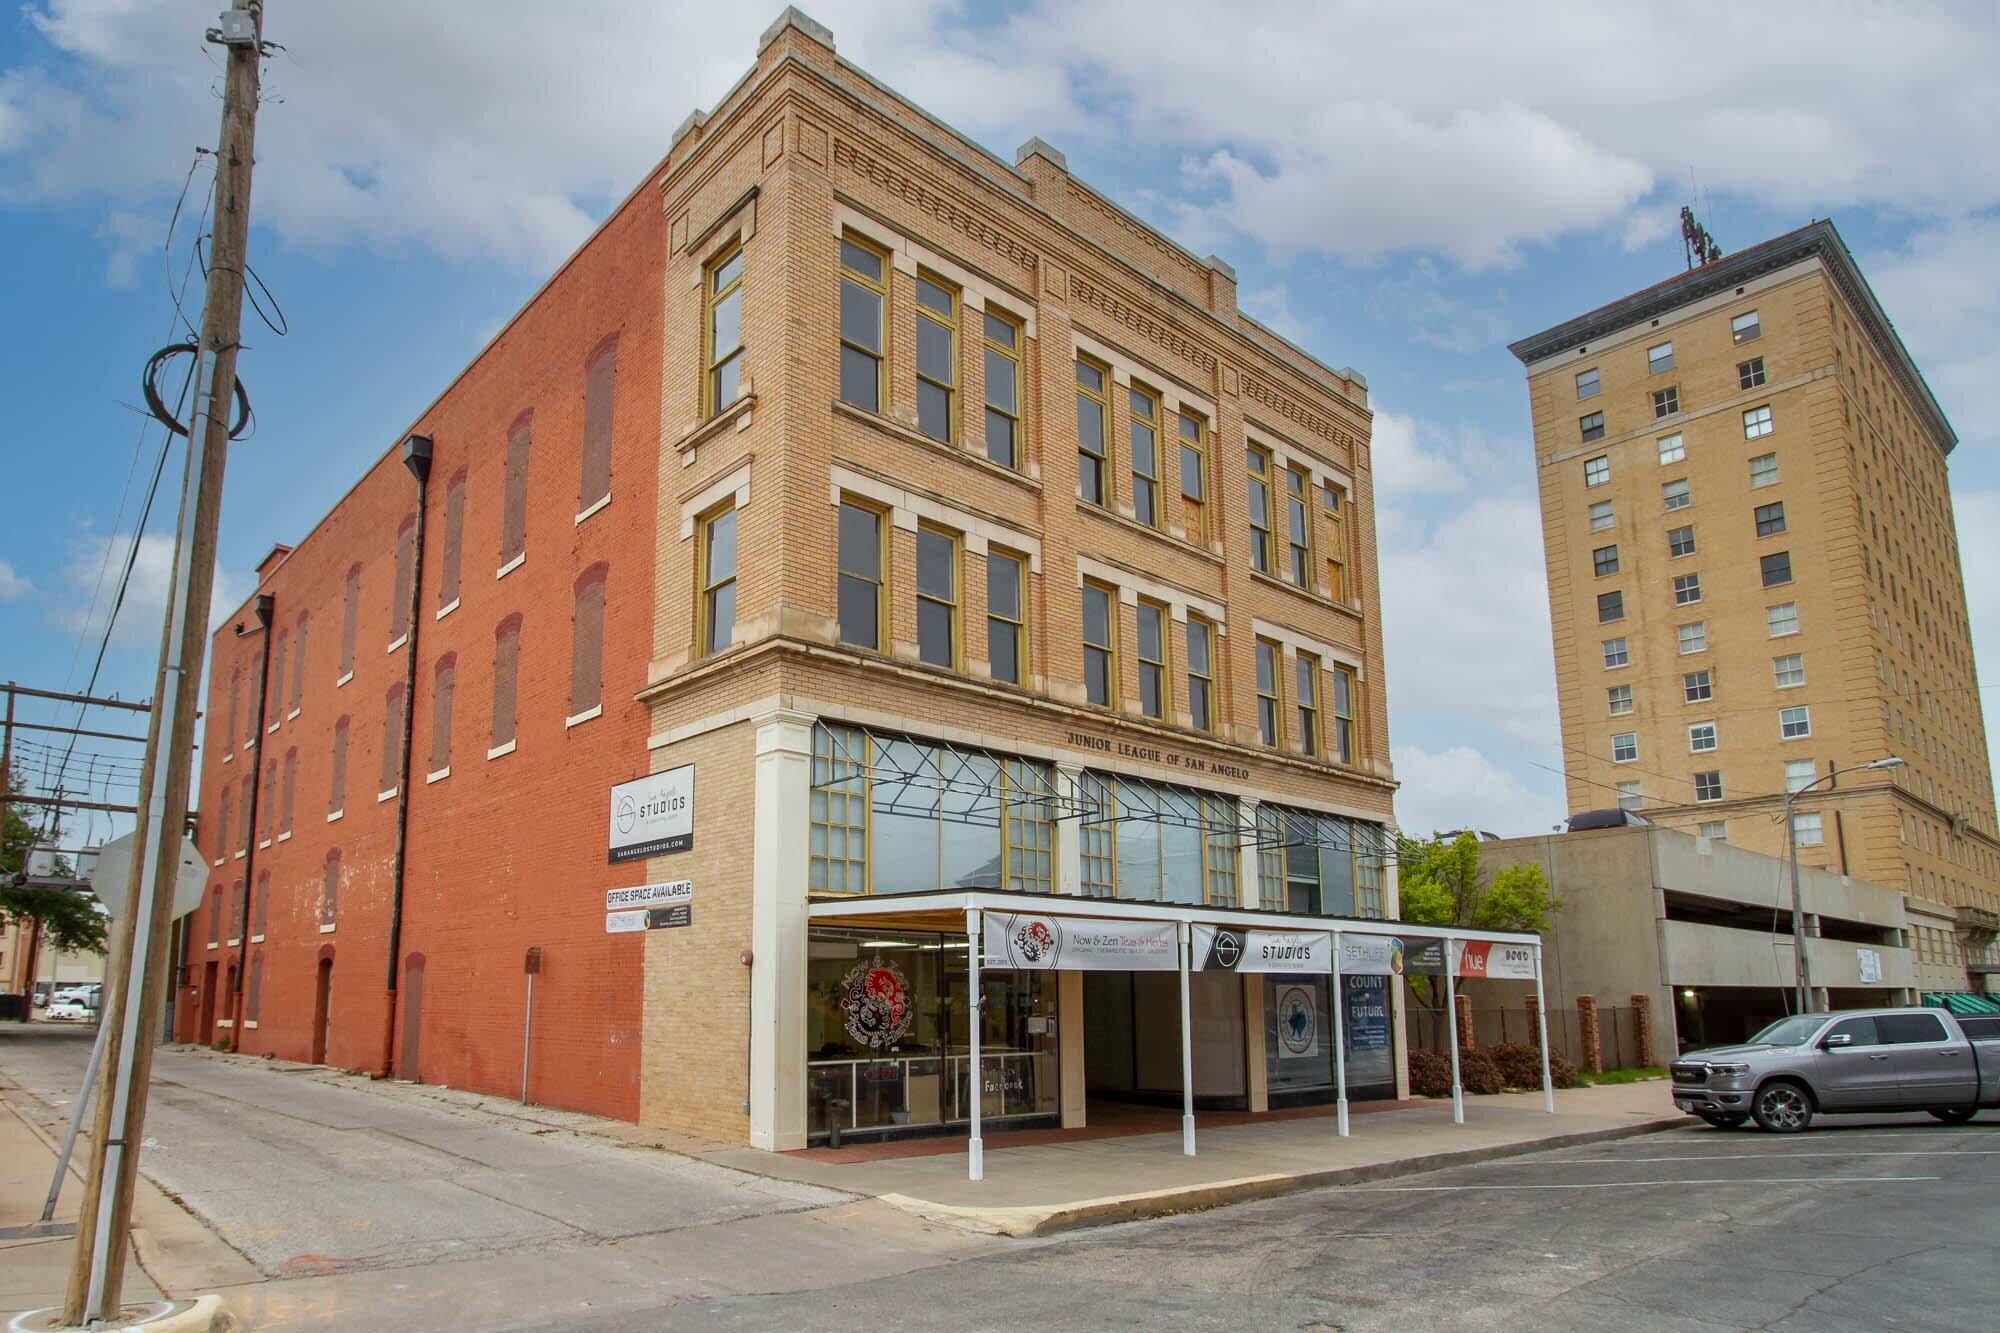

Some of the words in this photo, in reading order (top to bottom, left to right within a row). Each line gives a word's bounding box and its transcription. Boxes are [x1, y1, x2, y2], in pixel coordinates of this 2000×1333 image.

[1067, 732, 1112, 752] JUNIOR
[1118, 742, 1160, 762] LEAGUE
[1166, 753, 1180, 765] OF
[1185, 758, 1205, 771] SAN
[1210, 762, 1250, 780] ANGELO
[639, 796, 686, 818] STUDIOS
[617, 839, 684, 858] SANANGELOSTUDIOS.COM
[607, 890, 629, 904] OFFICE
[630, 887, 652, 901] SPACE
[652, 882, 691, 899] AVAILABLE
[1072, 933, 1092, 946] Now
[1093, 933, 1100, 946] &
[1102, 934, 1118, 946] Zen
[1119, 935, 1137, 947] Teas
[1146, 933, 1169, 947] Herbs
[1262, 945, 1311, 960] STUDIOS
[1465, 946, 1483, 970] hue
[1350, 975, 1383, 989] COUNT
[1351, 1005, 1384, 1017] FUTURE
